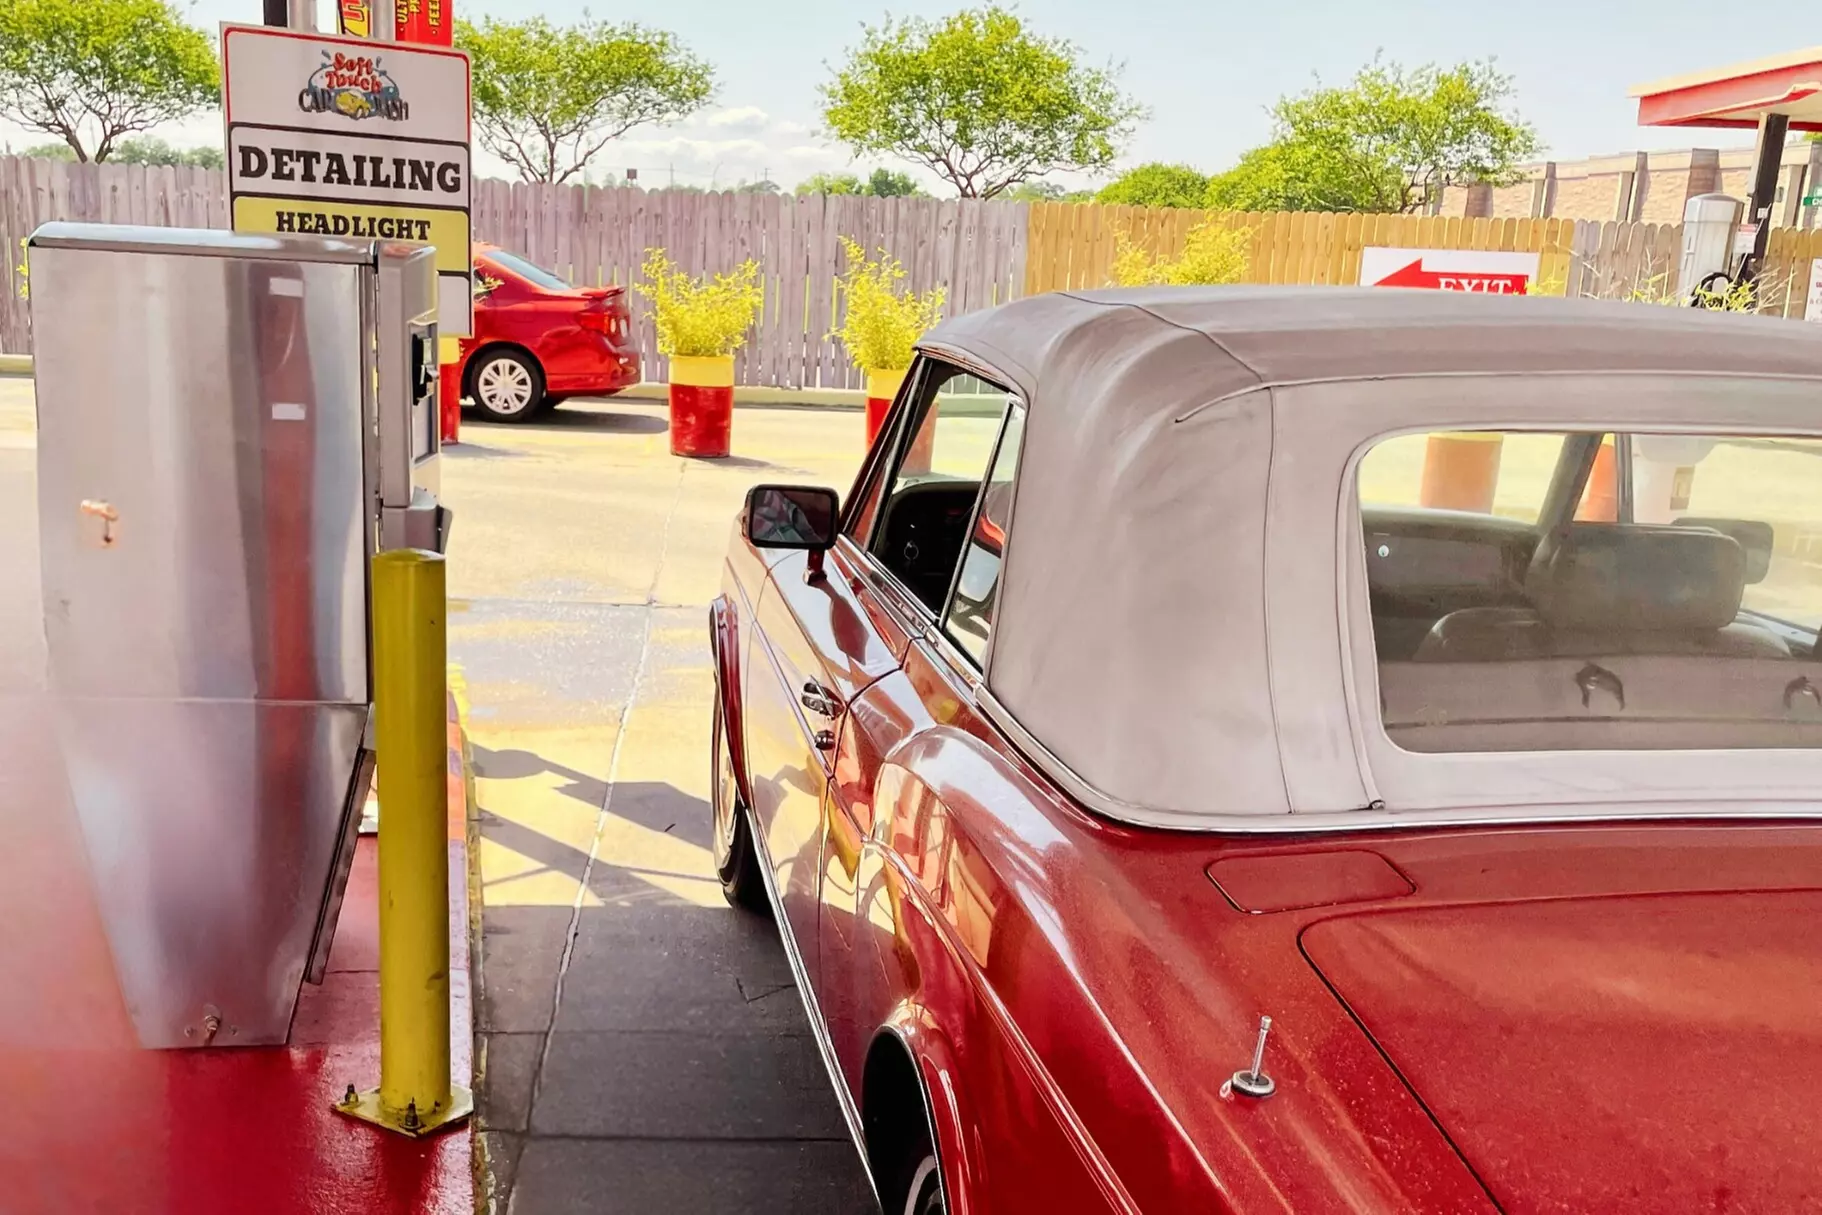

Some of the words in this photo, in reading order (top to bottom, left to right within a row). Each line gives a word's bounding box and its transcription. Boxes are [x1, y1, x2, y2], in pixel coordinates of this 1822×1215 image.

[429, 0, 440, 26] FEE
[332, 52, 373, 76] Soft
[325, 70, 382, 95] Touch
[238, 145, 461, 193] DETAILING
[275, 211, 431, 240] HEADLIGHT
